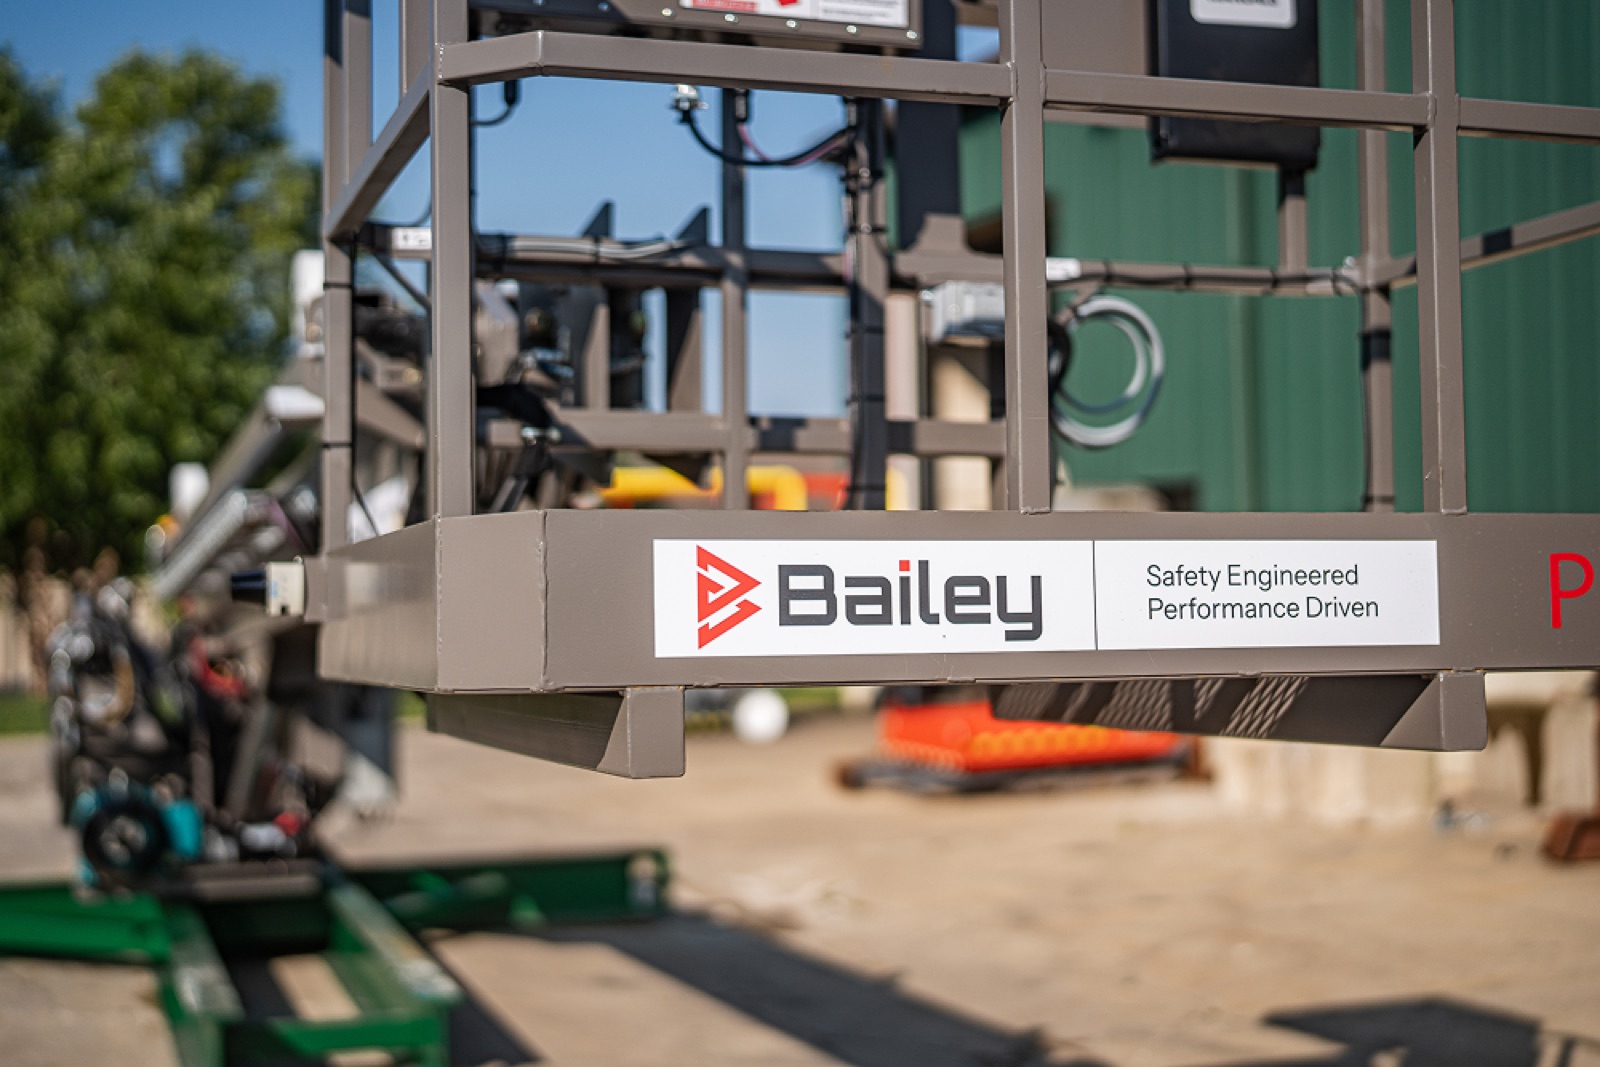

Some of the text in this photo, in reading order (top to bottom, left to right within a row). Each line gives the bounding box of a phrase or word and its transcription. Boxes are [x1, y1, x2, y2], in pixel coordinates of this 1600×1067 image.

[1146, 564, 1359, 592] Safety Engineered
[778, 560, 1042, 641] Bailey
[1148, 596, 1379, 620] Performance Driven
